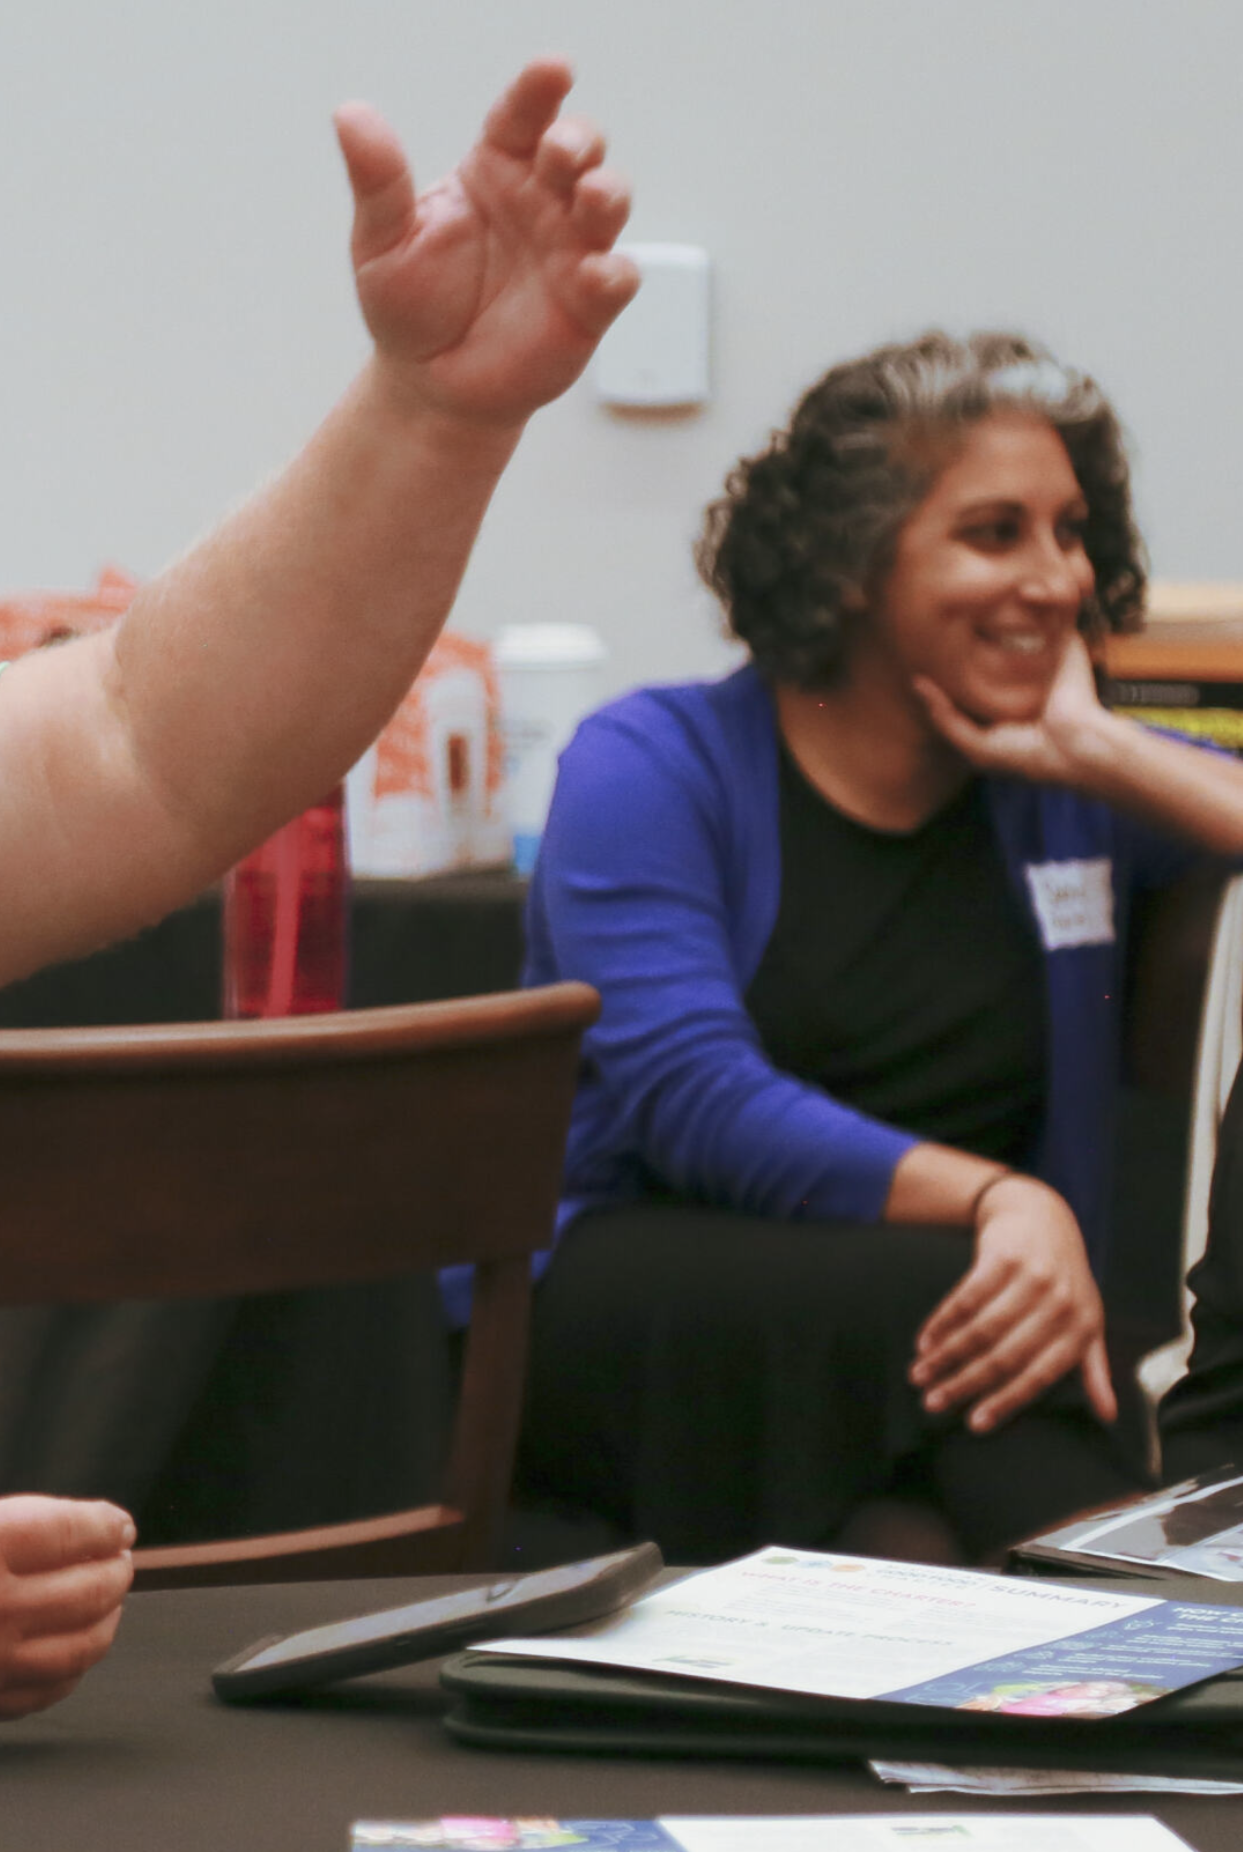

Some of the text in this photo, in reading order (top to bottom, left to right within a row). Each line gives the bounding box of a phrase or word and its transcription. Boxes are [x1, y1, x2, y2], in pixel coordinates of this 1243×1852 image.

[827, 1581, 868, 1592] THE
[989, 1585, 1125, 1609] SUMMARY
[665, 1610, 754, 1625] HISTORY
[780, 1624, 857, 1638] UPDATE
